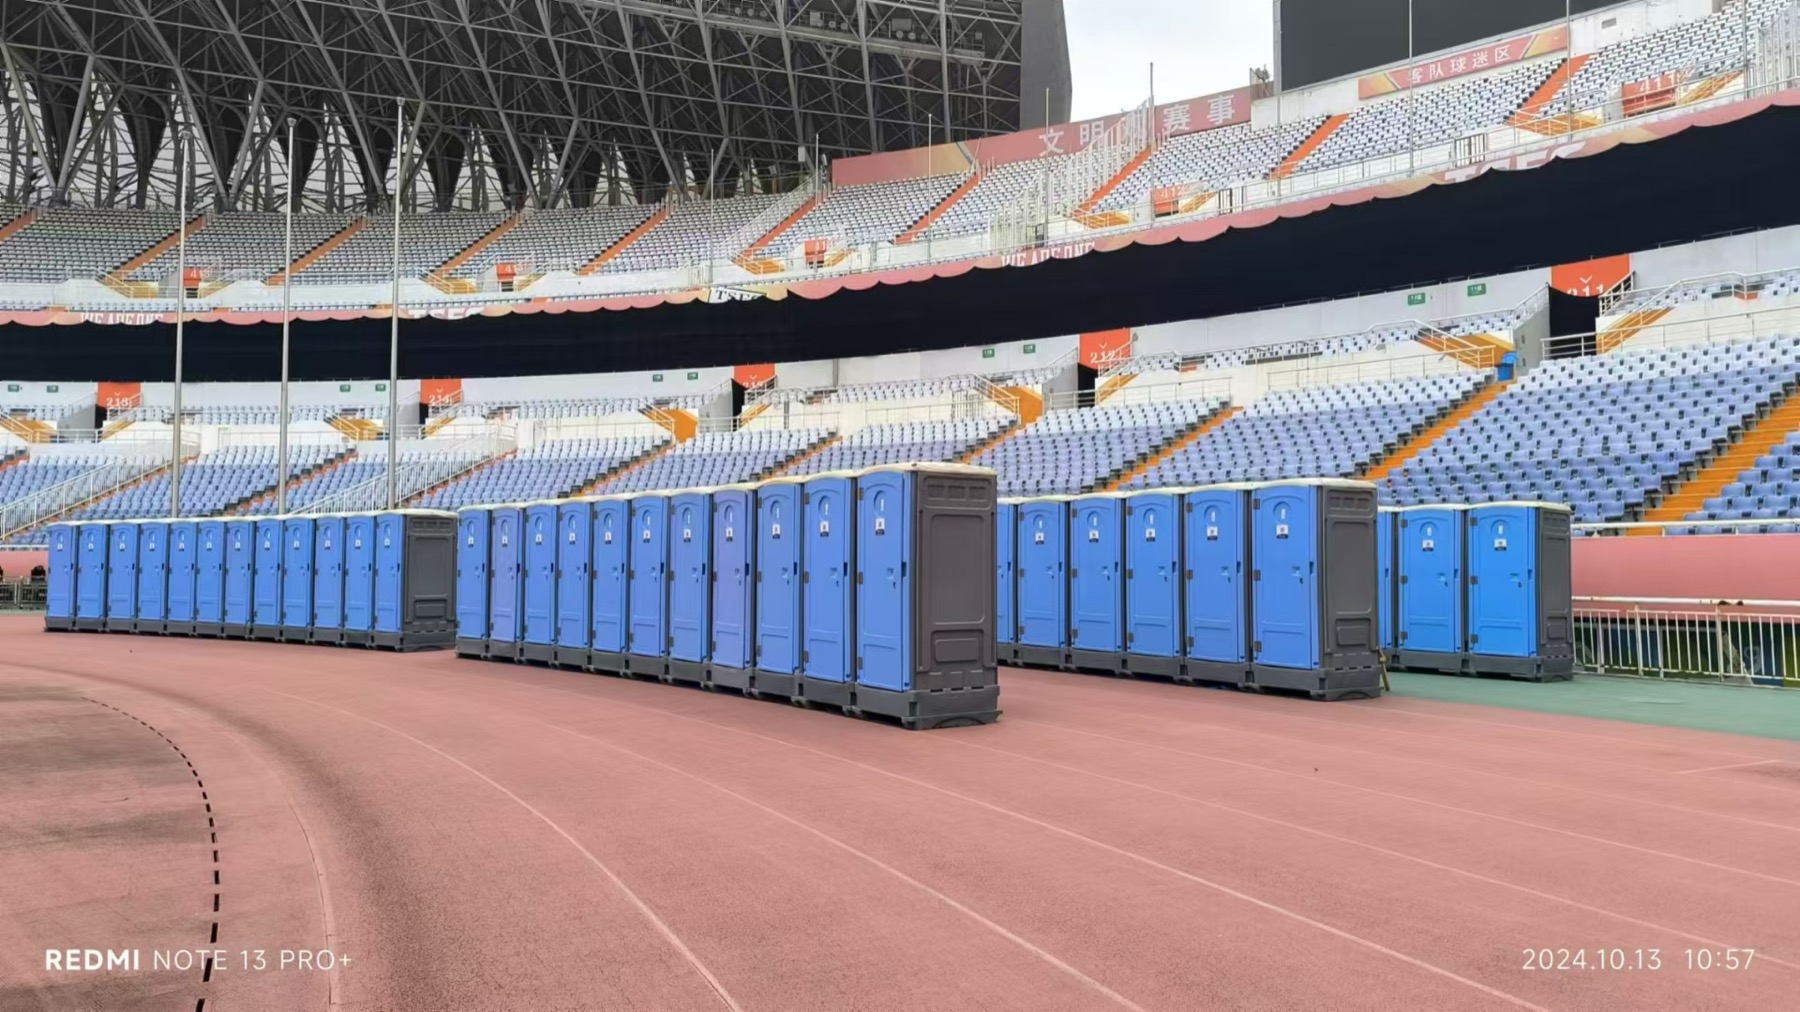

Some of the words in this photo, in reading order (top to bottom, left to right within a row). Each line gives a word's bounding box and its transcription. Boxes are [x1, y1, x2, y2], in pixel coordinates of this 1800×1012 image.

[1408, 46, 1511, 84] 客队球迷区
[1038, 95, 1234, 157] 文明赛事
